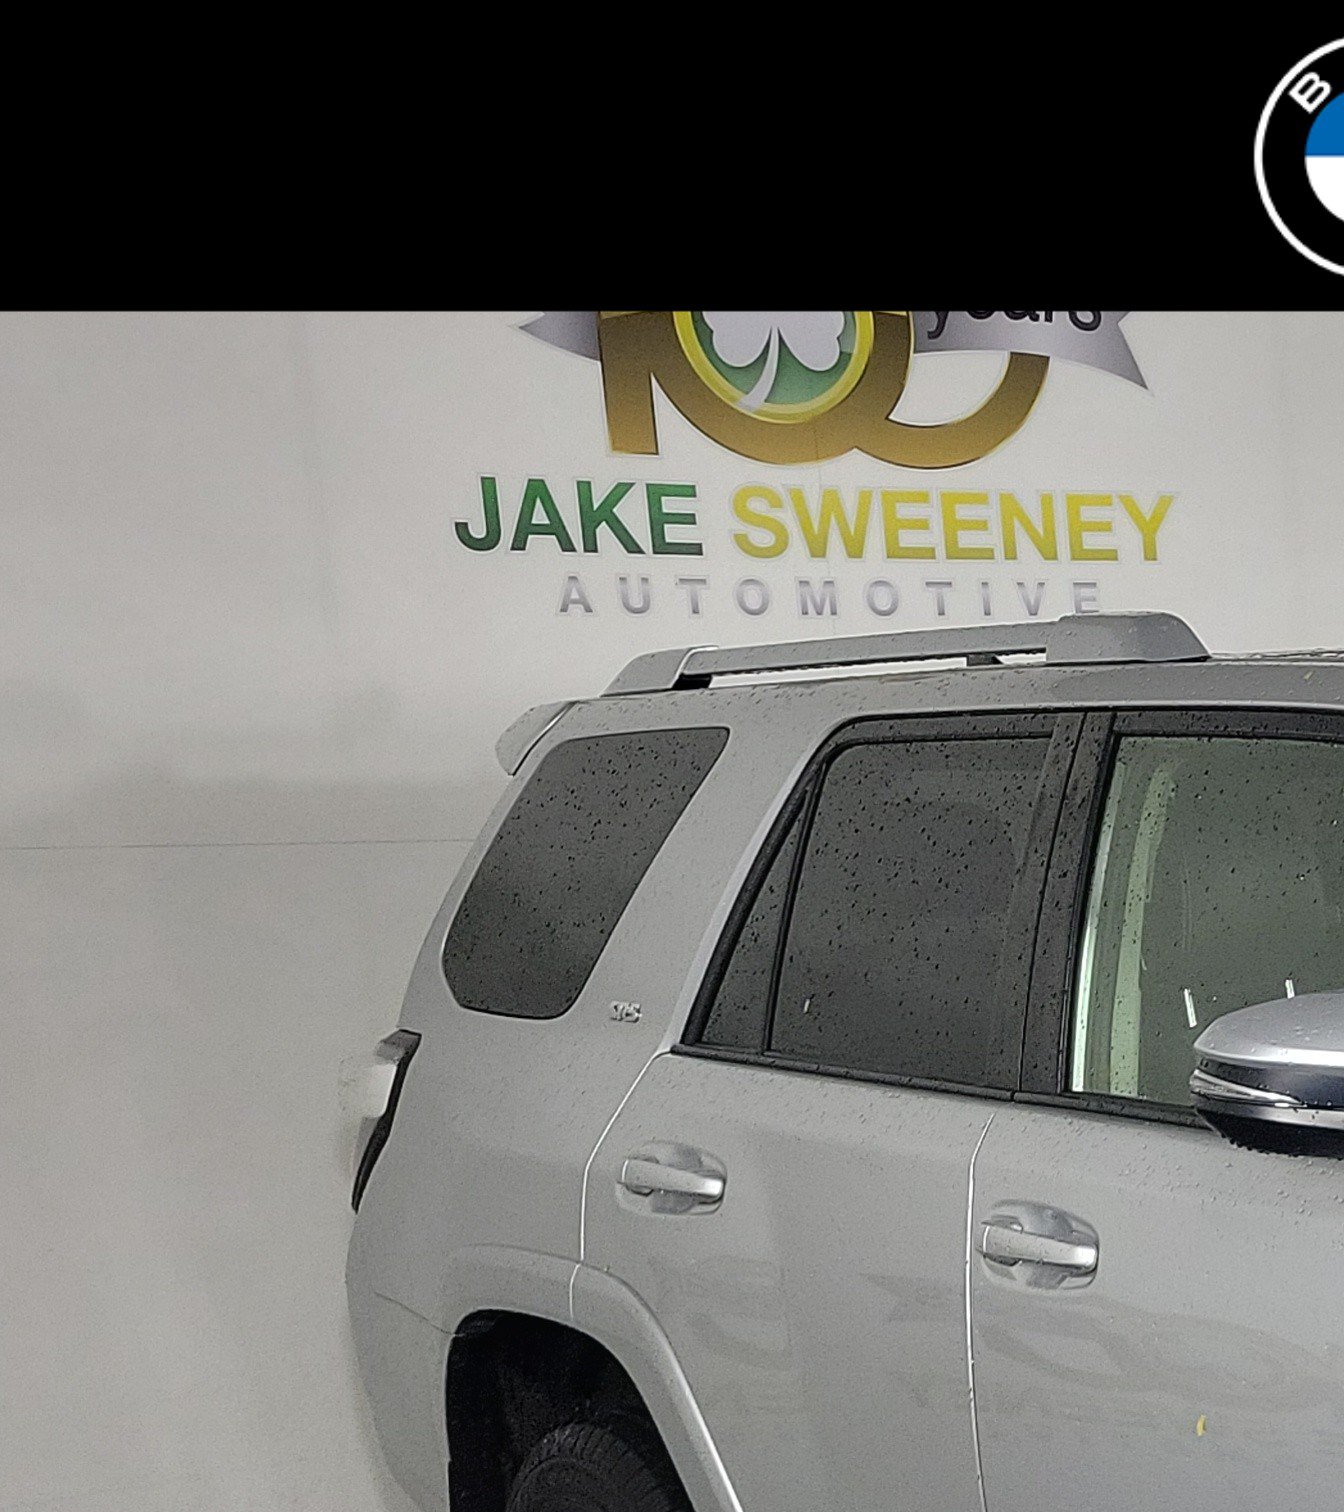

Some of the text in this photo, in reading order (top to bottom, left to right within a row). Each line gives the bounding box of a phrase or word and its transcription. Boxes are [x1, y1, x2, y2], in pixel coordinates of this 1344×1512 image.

[454, 475, 1175, 562] JAKE SWEENEY
[558, 576, 1102, 617] AUTOMOTIVE
